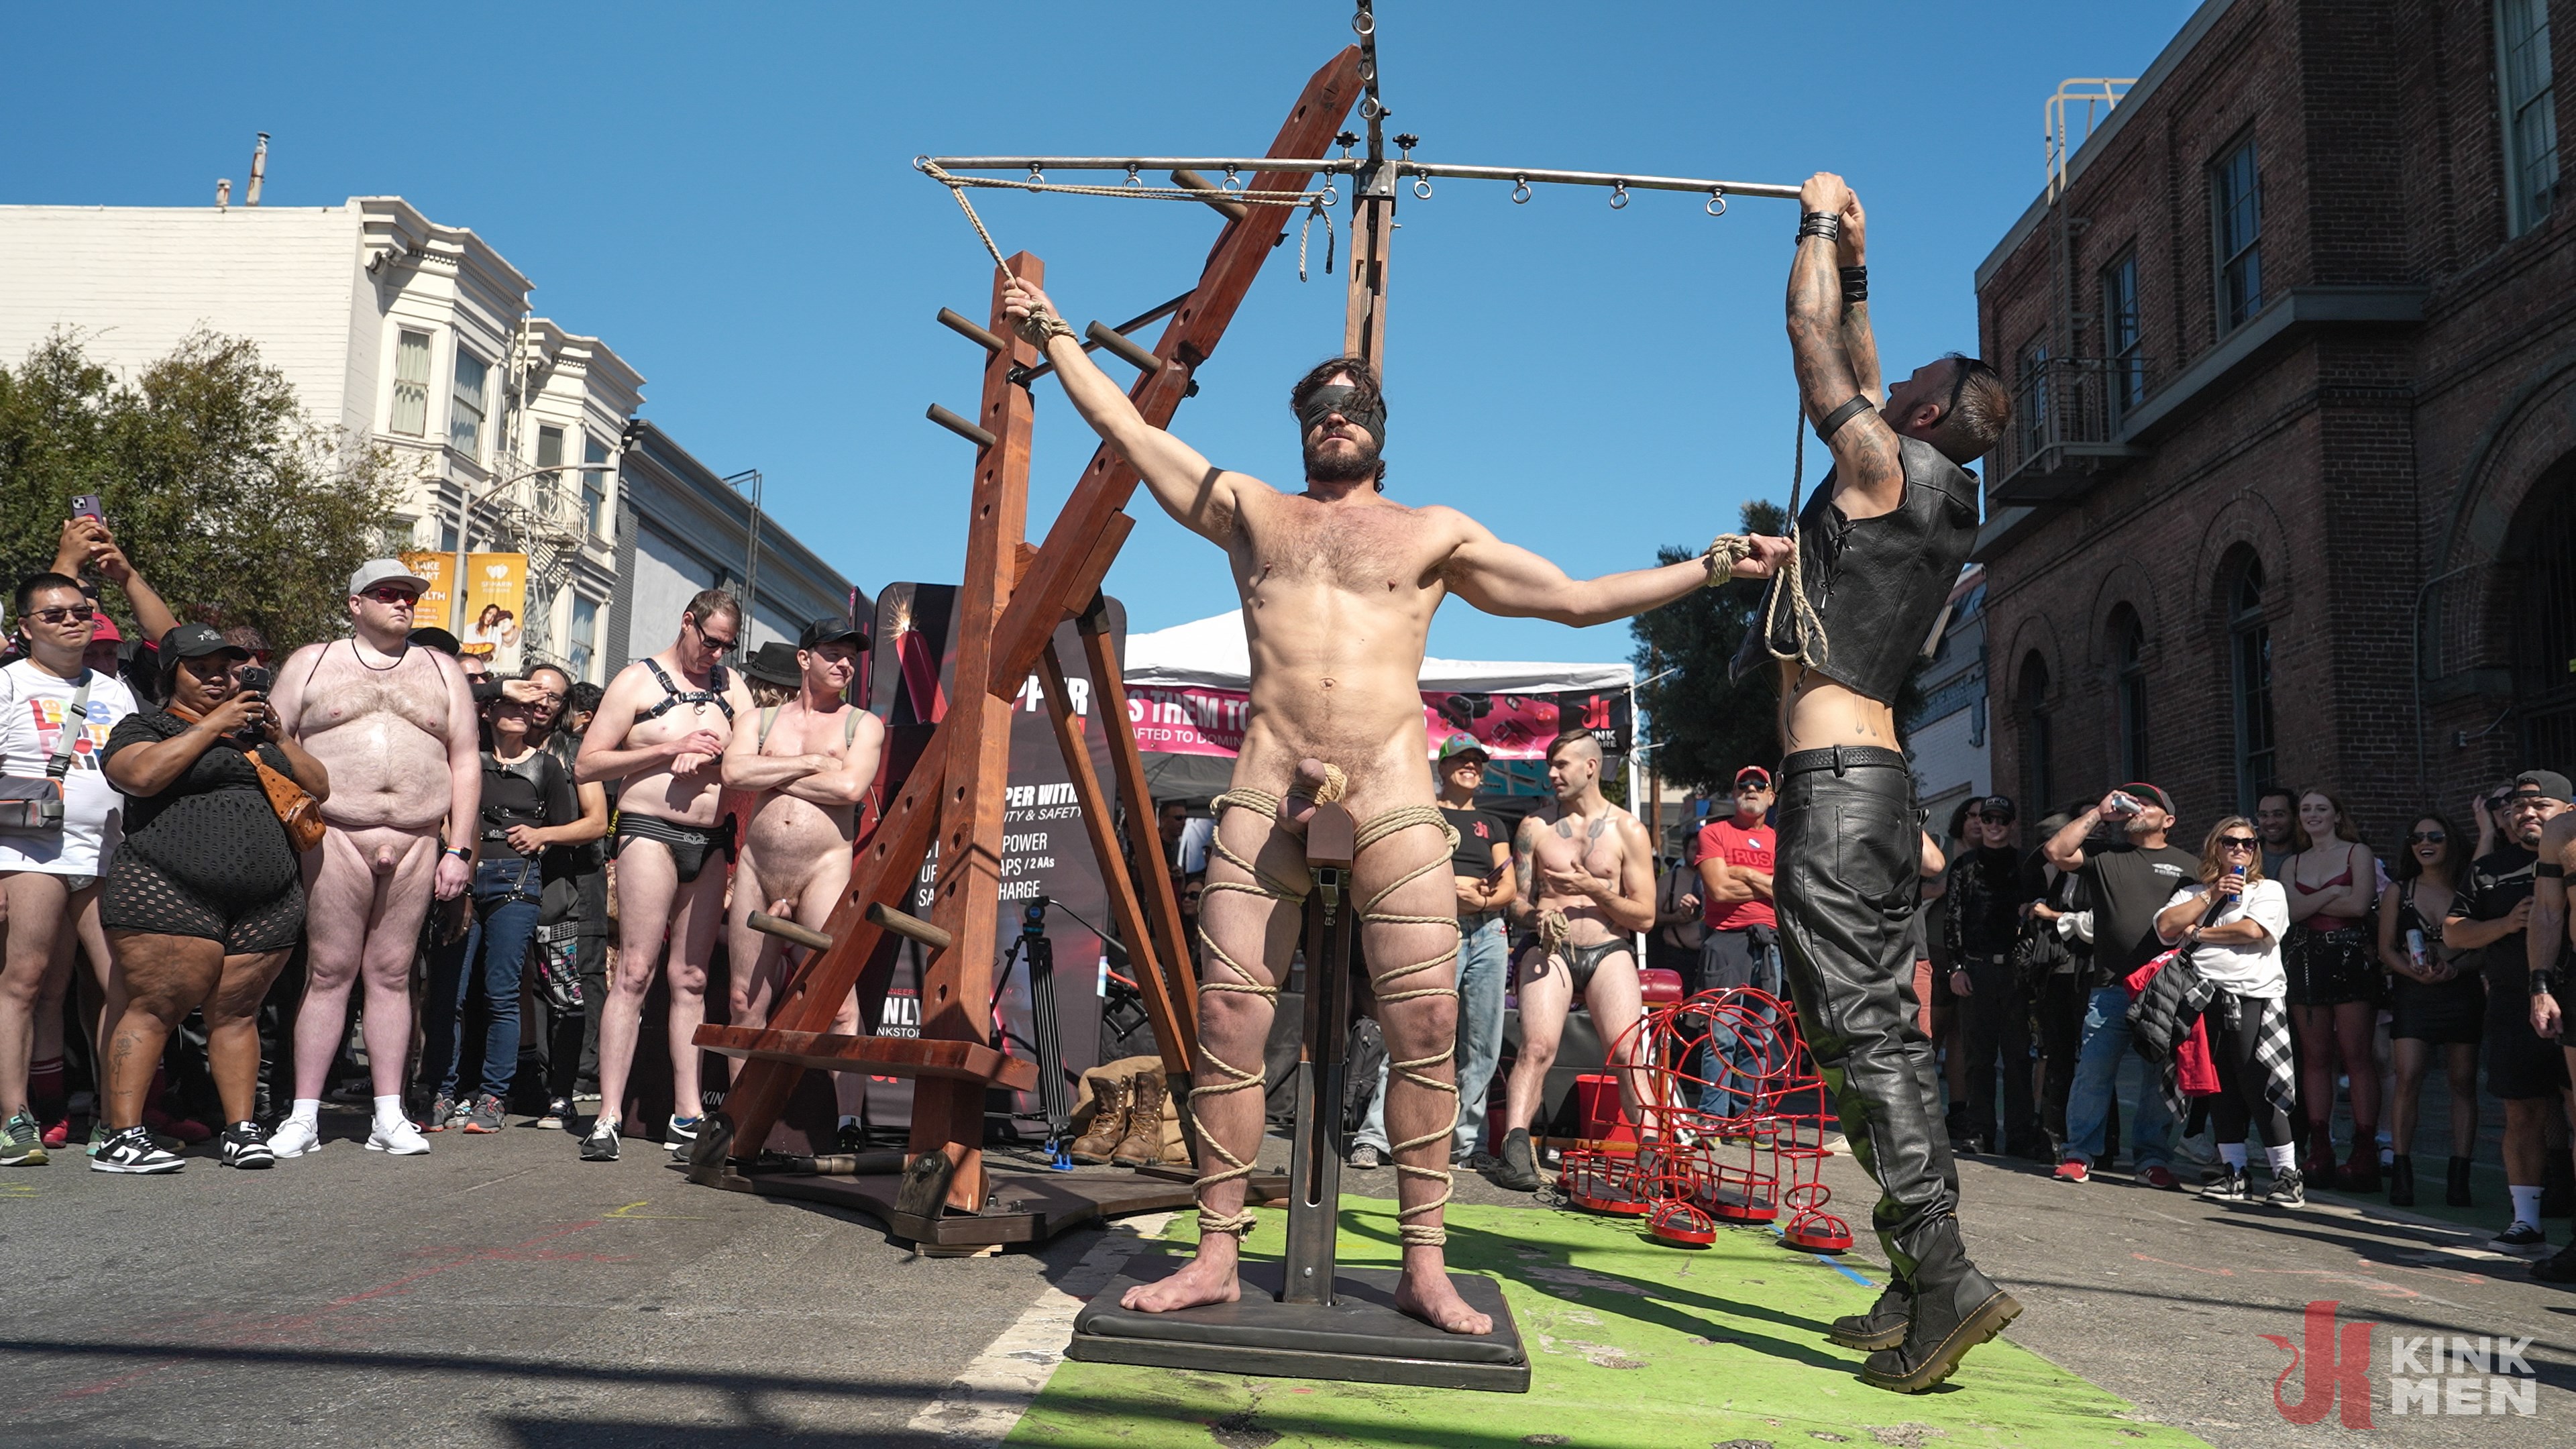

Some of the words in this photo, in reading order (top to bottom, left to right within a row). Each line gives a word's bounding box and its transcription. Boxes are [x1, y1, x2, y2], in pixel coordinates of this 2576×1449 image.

[1150, 690, 1219, 730] THEM
[1175, 730, 1193, 743] TO
[1025, 809, 1036, 822] &
[1002, 832, 1048, 853] POWER
